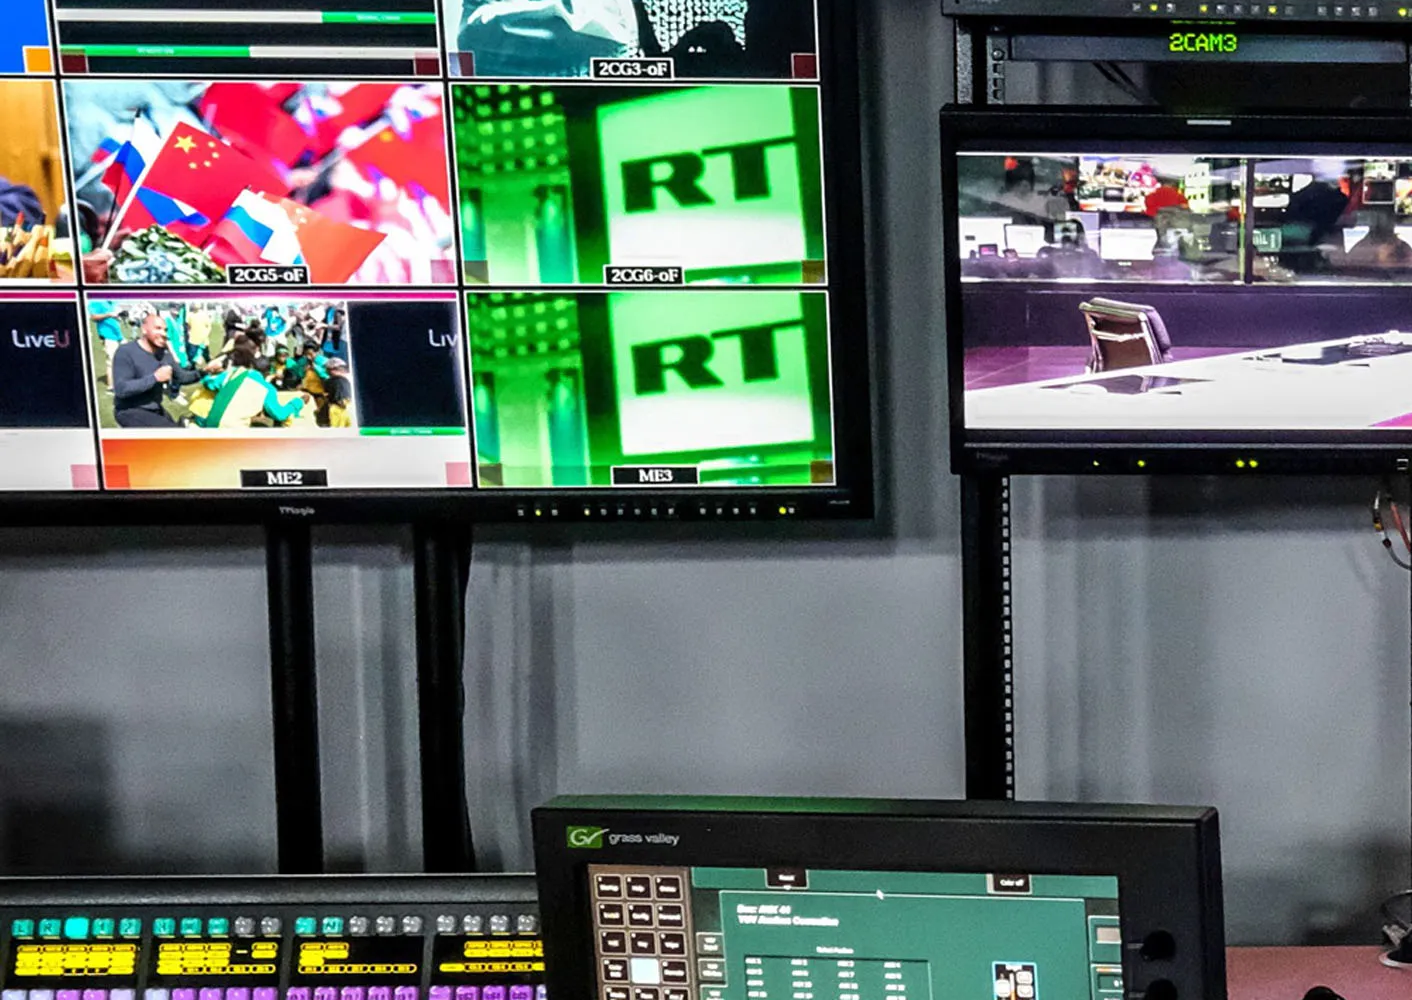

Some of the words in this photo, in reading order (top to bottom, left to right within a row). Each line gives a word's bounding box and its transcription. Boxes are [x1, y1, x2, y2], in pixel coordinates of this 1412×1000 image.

[1169, 32, 1237, 52] 2CAM3
[599, 61, 668, 77] 2CG3-oF
[620, 136, 798, 213] RT
[234, 267, 304, 282] 2CG5-oF
[611, 267, 679, 283] 2CG6-oF
[12, 329, 70, 349] LiveU
[631, 319, 803, 395] RT
[267, 470, 303, 485] ME2
[638, 468, 673, 482] ME3
[608, 833, 642, 846] grass
[644, 832, 680, 847] valley
